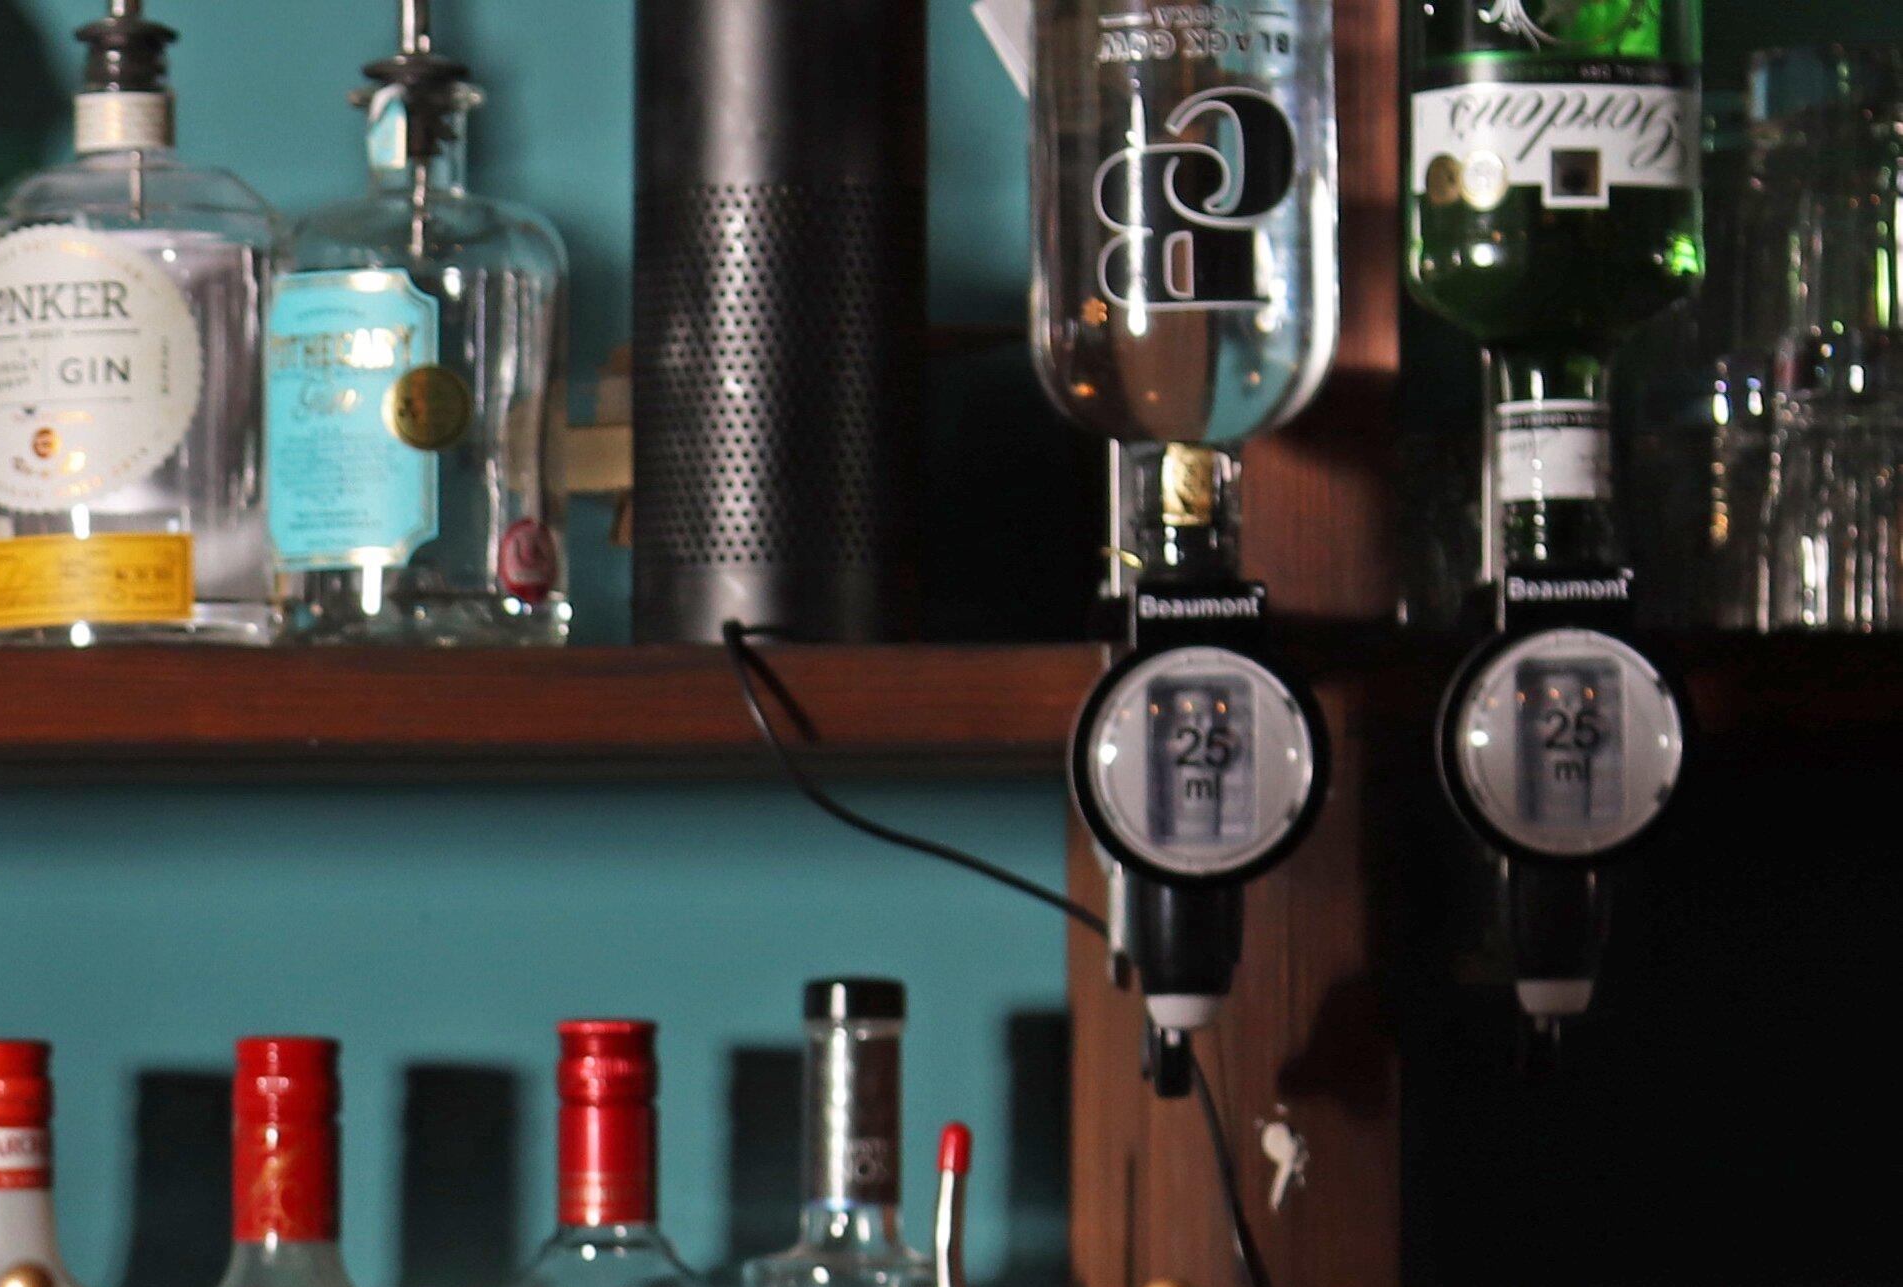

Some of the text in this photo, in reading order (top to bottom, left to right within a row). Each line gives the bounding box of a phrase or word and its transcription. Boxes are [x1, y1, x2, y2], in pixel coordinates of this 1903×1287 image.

[60, 355, 132, 387] GIN
[1508, 577, 1629, 600] Beaumont
[1138, 594, 1261, 619] Beaumont
[1175, 727, 1231, 768] 25
[1545, 710, 1600, 753] 25
